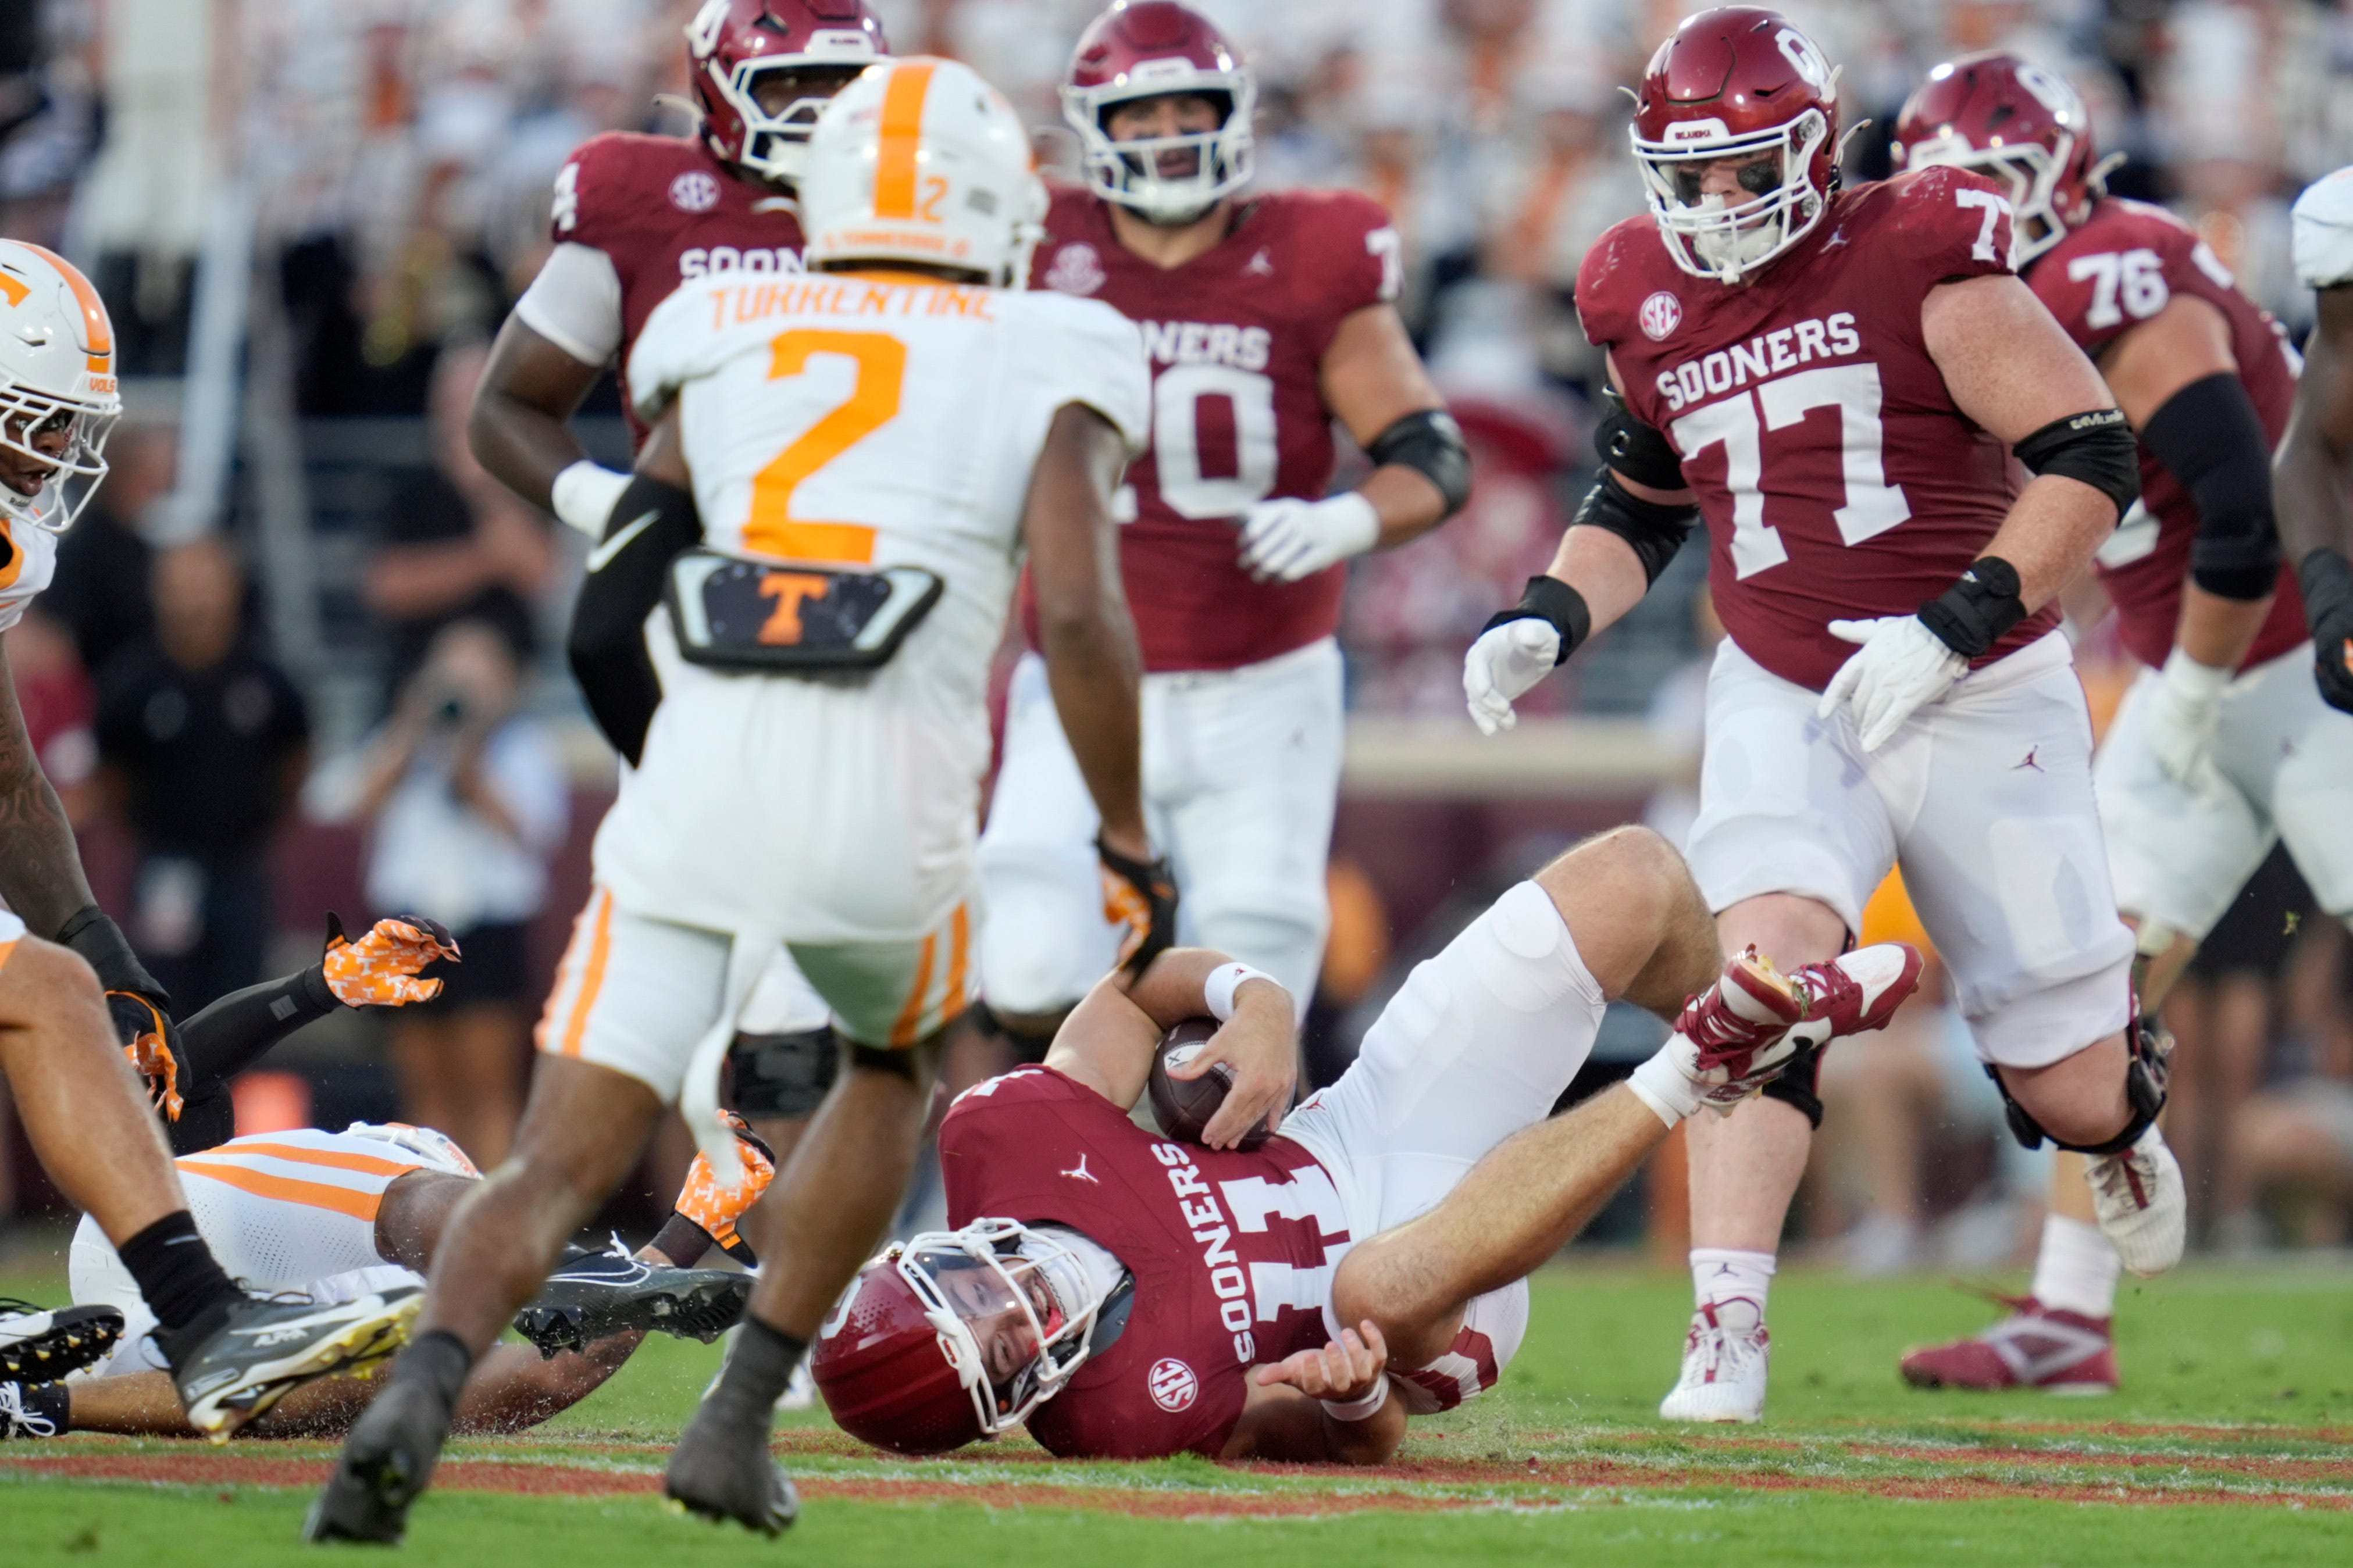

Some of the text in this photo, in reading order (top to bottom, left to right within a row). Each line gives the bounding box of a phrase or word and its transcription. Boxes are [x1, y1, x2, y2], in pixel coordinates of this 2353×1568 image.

[922, 176, 949, 223] 2
[679, 246, 808, 285] SOON
[2068, 249, 2170, 329] 76
[1143, 320, 1272, 372] NERS
[1642, 293, 1680, 339] SEC
[1656, 312, 1860, 412] SOONERS
[740, 328, 908, 565] 2
[1671, 362, 1912, 580] 77
[758, 572, 828, 646] T
[1151, 1143, 1256, 1363] SOONERS
[1218, 1164, 1351, 1323] 11
[1151, 1360, 1196, 1409] SEC
